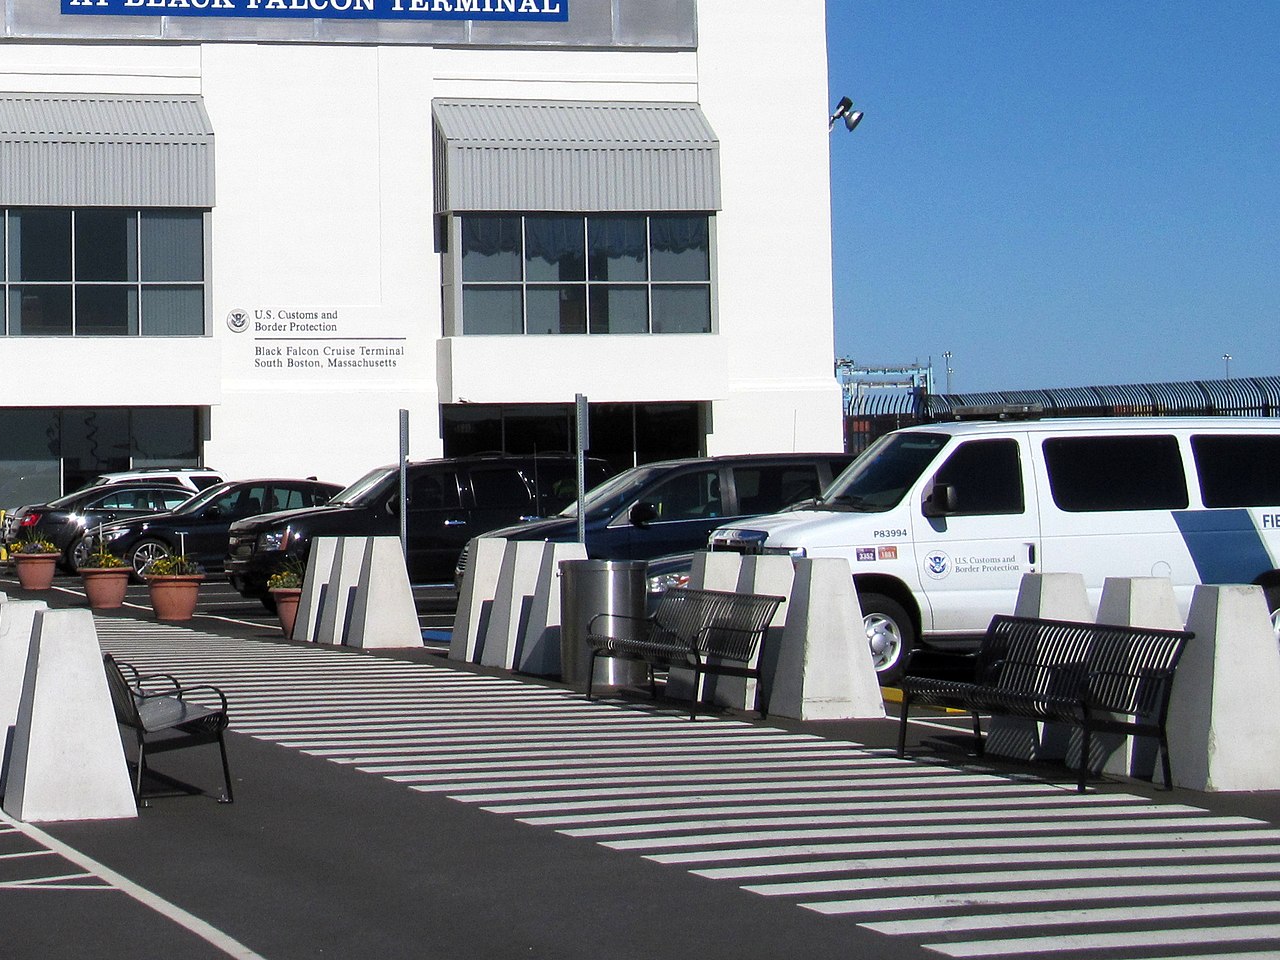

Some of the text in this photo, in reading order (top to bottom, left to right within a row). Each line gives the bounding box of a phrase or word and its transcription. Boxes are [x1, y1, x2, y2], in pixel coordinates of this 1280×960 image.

[255, 310, 338, 319] U.S. Customs and
[255, 322, 337, 332] Border Protection
[255, 346, 404, 356] Black Falcon Cruise Terminal
[255, 358, 397, 368] South Boston, Massachusetts
[874, 529, 907, 537] P83994
[982, 564, 1019, 572] Protection
